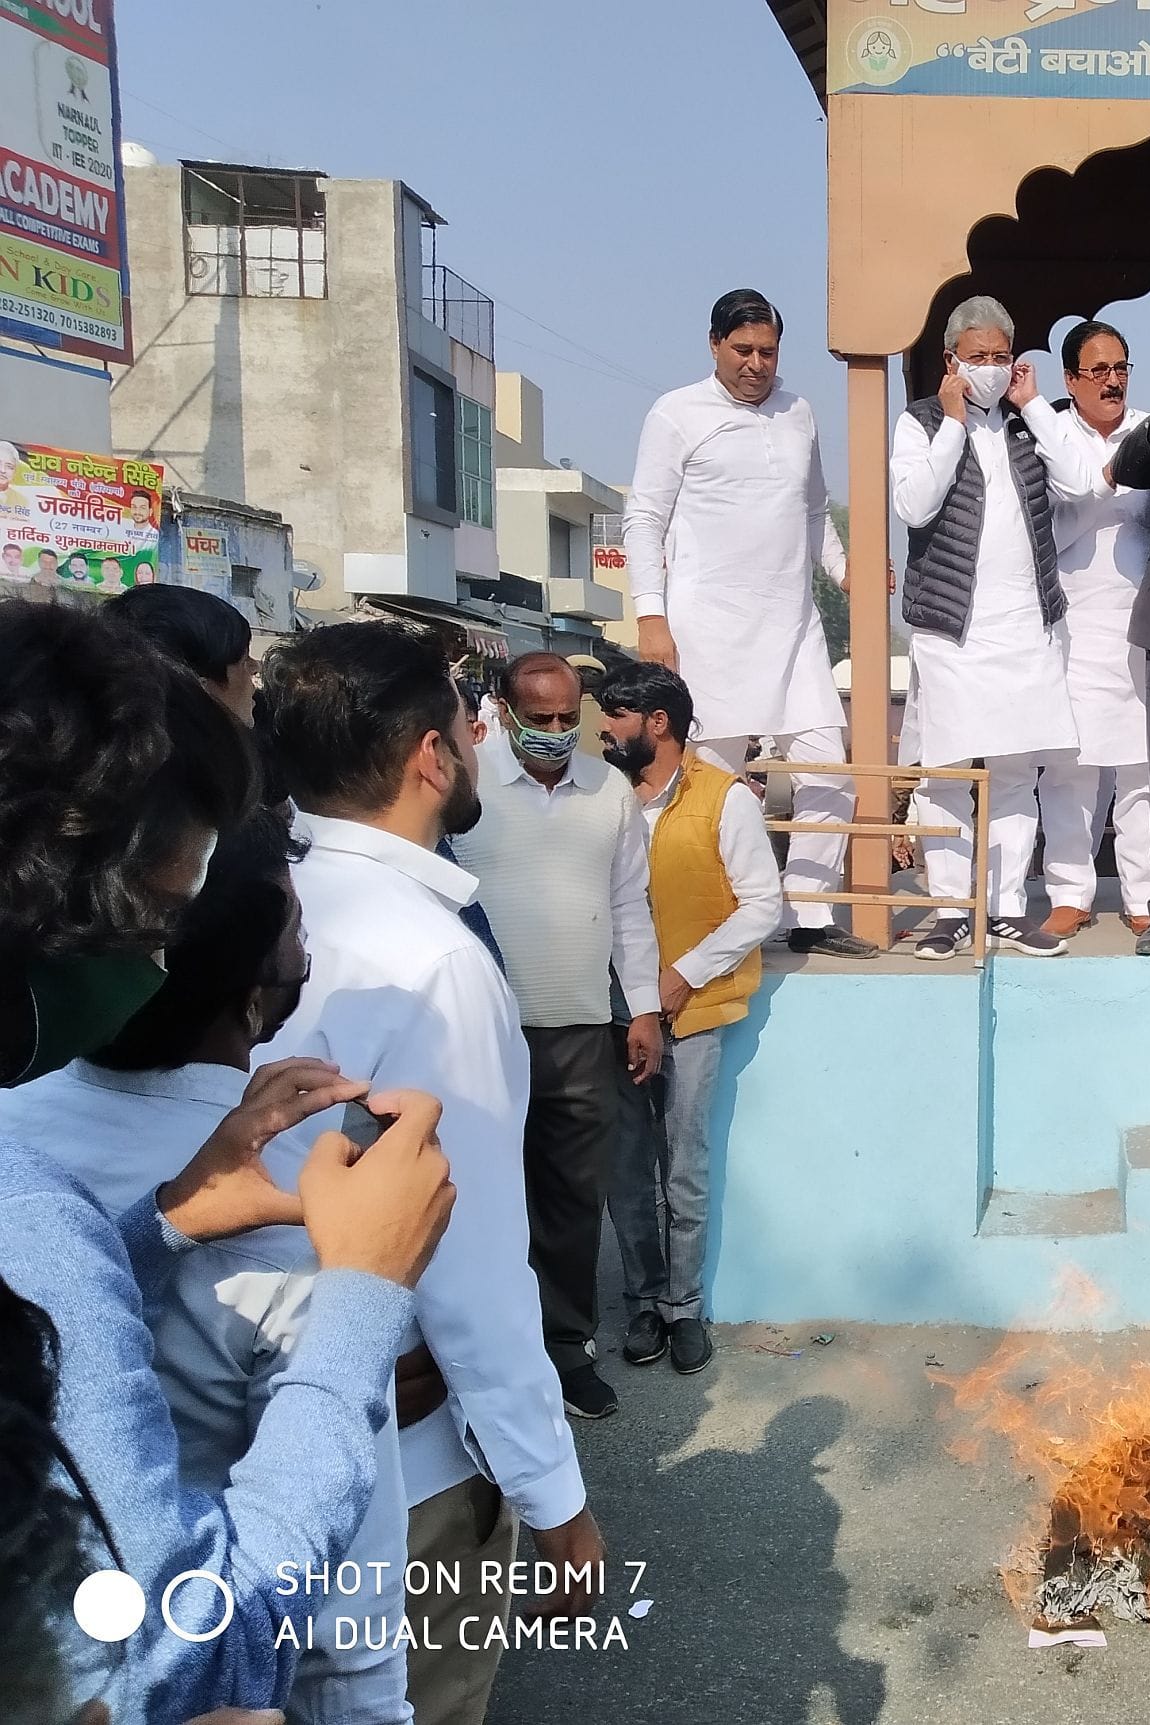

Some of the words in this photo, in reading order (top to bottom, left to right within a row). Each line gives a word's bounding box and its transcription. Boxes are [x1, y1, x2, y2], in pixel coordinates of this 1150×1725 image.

[57, 102, 102, 135] NARNAUL
[62, 125, 100, 153] TOPPER
[88, 155, 113, 180] 2020
[72, 232, 100, 254] EXAMS
[6, 246, 39, 263] School
[75, 268, 97, 281] Care
[32, 264, 112, 309] KIDS
[0, 298, 57, 327] 82-251320,
[60, 314, 118, 341] 7015382893
[27, 452, 62, 472] राव
[66, 455, 119, 483] नरेन्द्र
[122, 461, 161, 489] सिंह
[35, 494, 123, 525] जन्मदिन
[7, 526, 51, 544] हार्दिक
[186, 531, 220, 556] पंचर
